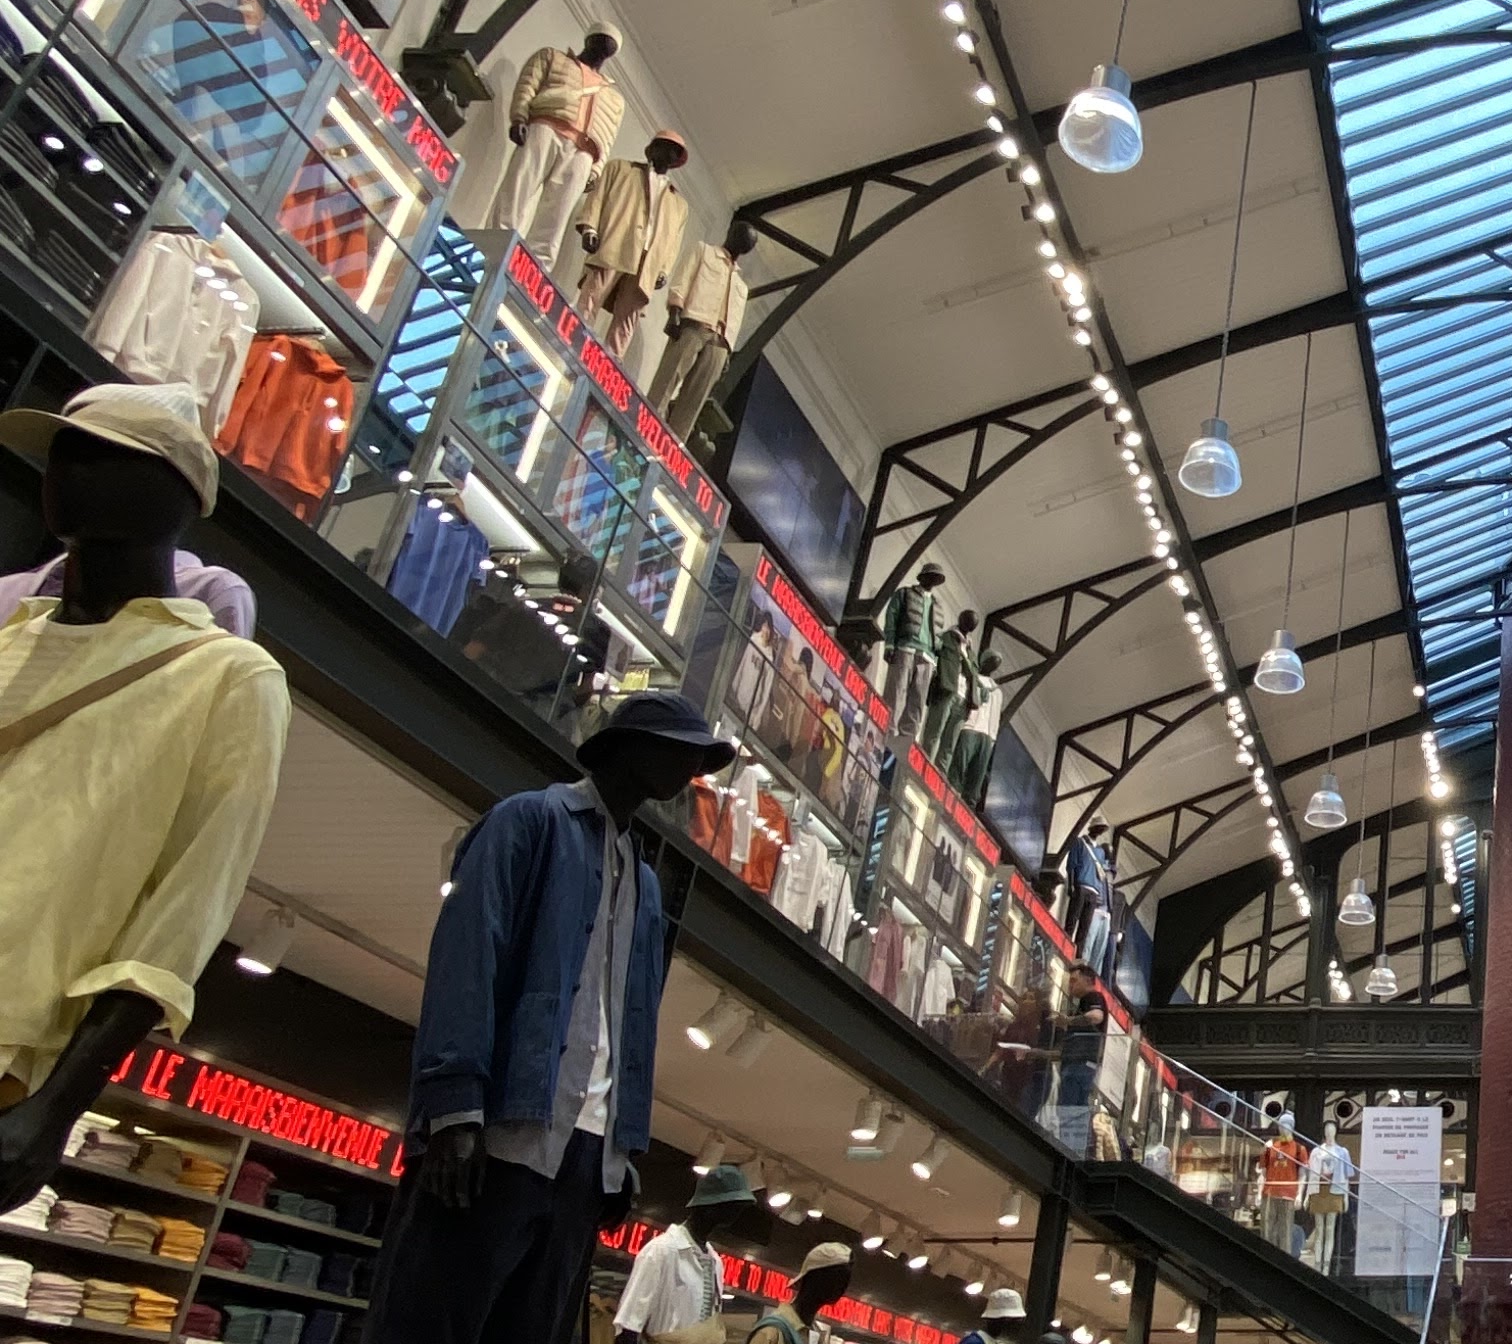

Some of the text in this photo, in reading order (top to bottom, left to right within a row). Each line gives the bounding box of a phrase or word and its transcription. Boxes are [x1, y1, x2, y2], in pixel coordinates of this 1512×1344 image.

[337, 19, 405, 122] VOTRE
[556, 304, 579, 347] LE
[580, 342, 634, 412] MARAIS
[636, 402, 693, 490] WELCOME
[696, 477, 713, 513] TO
[756, 555, 773, 588] LE
[141, 1048, 185, 1100] LE
[187, 1064, 390, 1170] MARAISBIENVENUE
